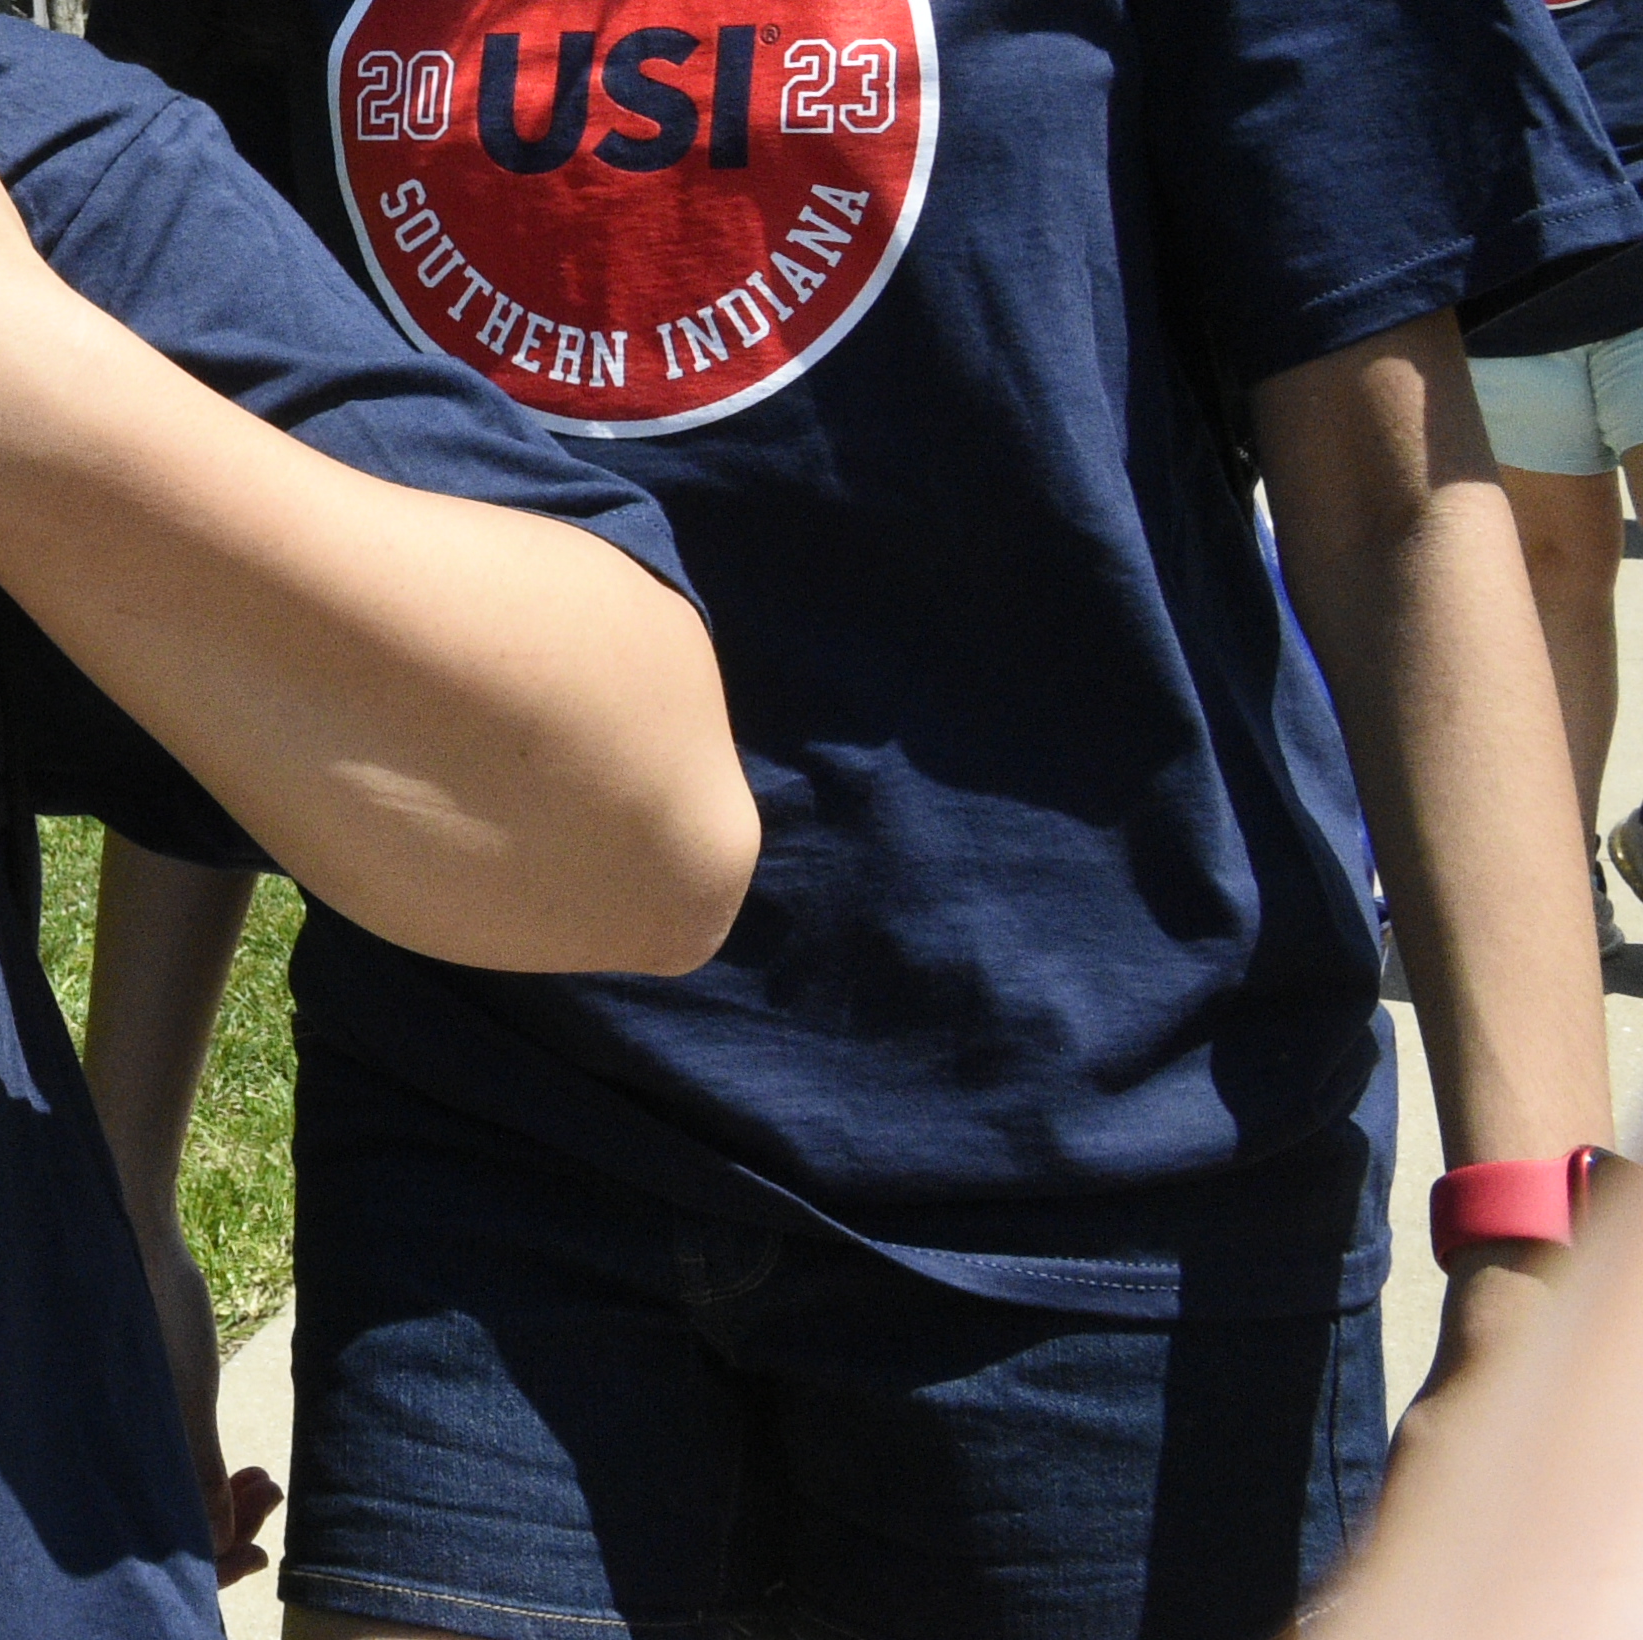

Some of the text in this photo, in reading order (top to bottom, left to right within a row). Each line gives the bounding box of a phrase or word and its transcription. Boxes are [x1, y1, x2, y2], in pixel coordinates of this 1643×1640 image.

[357, 50, 454, 141] 20
[780, 38, 898, 134] 23
[380, 178, 869, 388] SOUTHERN INDIANA
